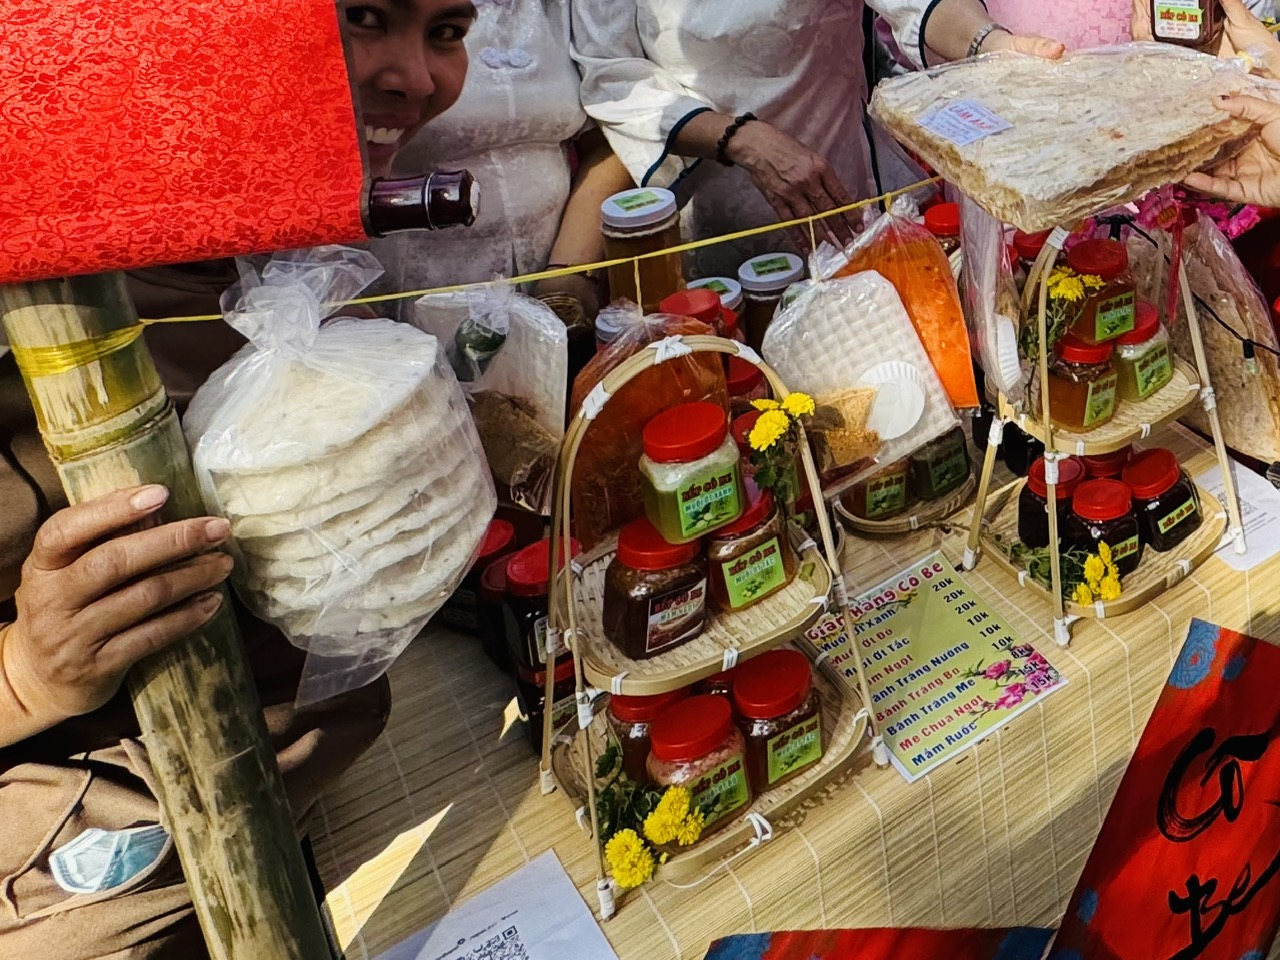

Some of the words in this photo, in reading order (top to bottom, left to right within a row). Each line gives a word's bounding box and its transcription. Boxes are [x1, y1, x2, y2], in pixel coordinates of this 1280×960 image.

[932, 577, 954, 592] 20k
[943, 588, 965, 603] 20k
[955, 599, 977, 614] 20k
[967, 611, 989, 626] 10k
[991, 634, 1014, 650] 10k
[872, 683, 896, 703] ánh
[979, 622, 1002, 638] 10k
[955, 678, 976, 694] Me
[899, 734, 921, 751] Me
[921, 714, 954, 737] Chua
